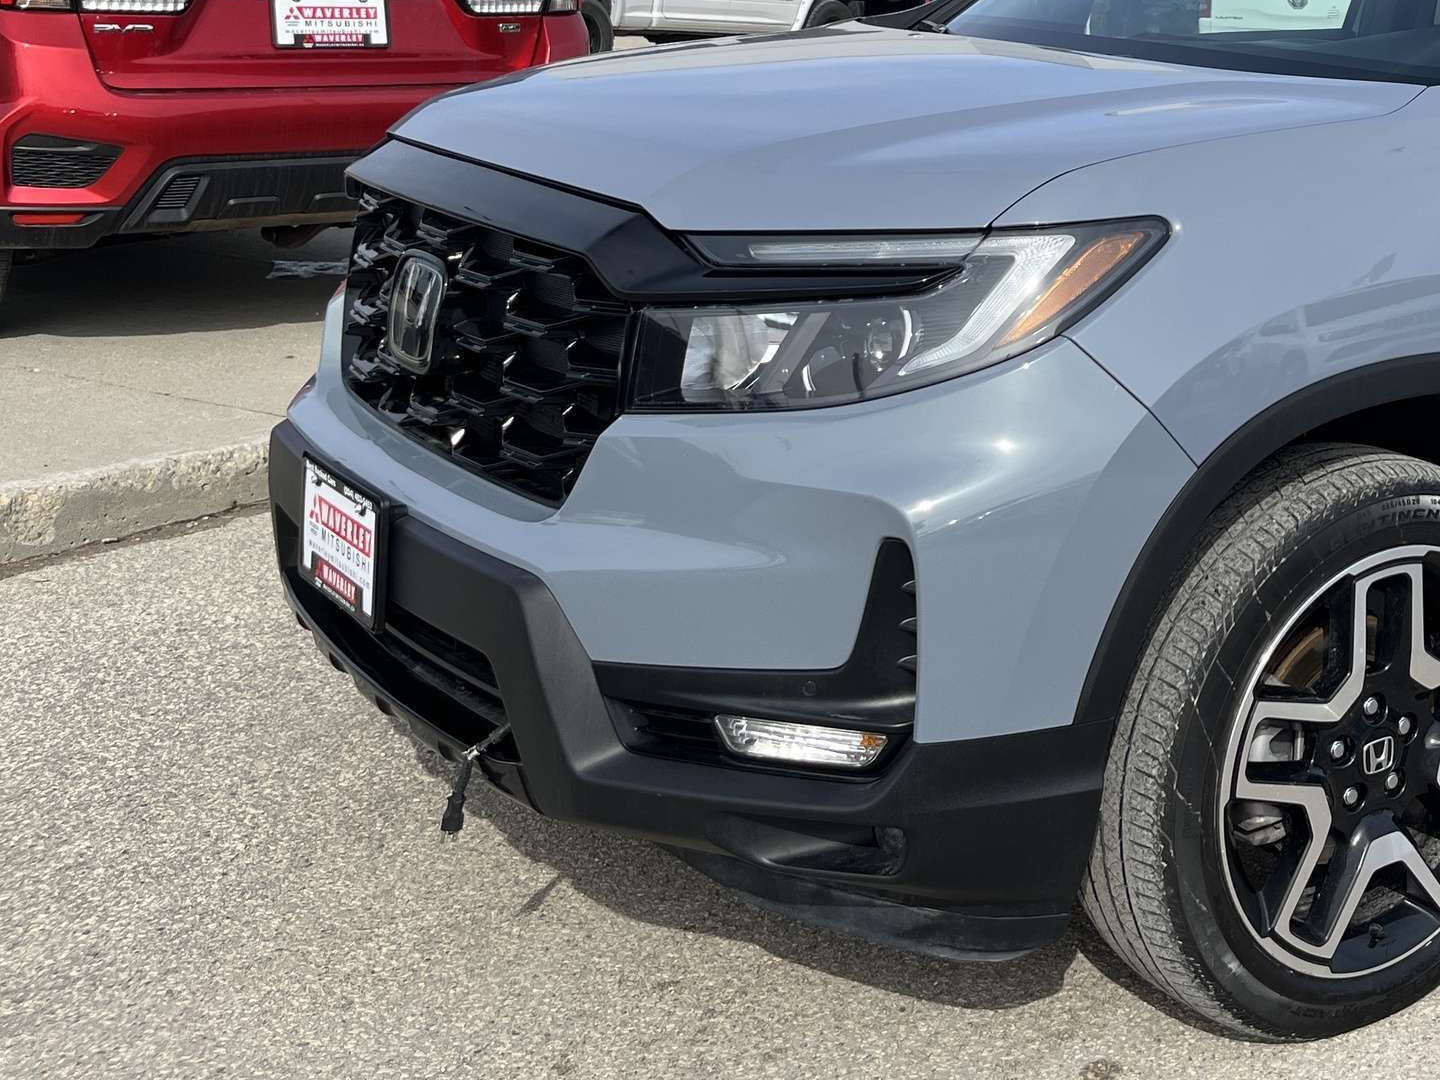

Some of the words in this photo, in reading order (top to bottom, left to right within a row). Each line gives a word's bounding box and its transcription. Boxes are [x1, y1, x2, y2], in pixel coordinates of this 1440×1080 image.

[302, 6, 377, 19] WAVERLEY
[313, 34, 364, 42] WAVERLEY
[320, 500, 371, 555] WAVERLEY
[321, 527, 370, 574] MITSUBISHI
[322, 563, 356, 601] WAVERLEY
